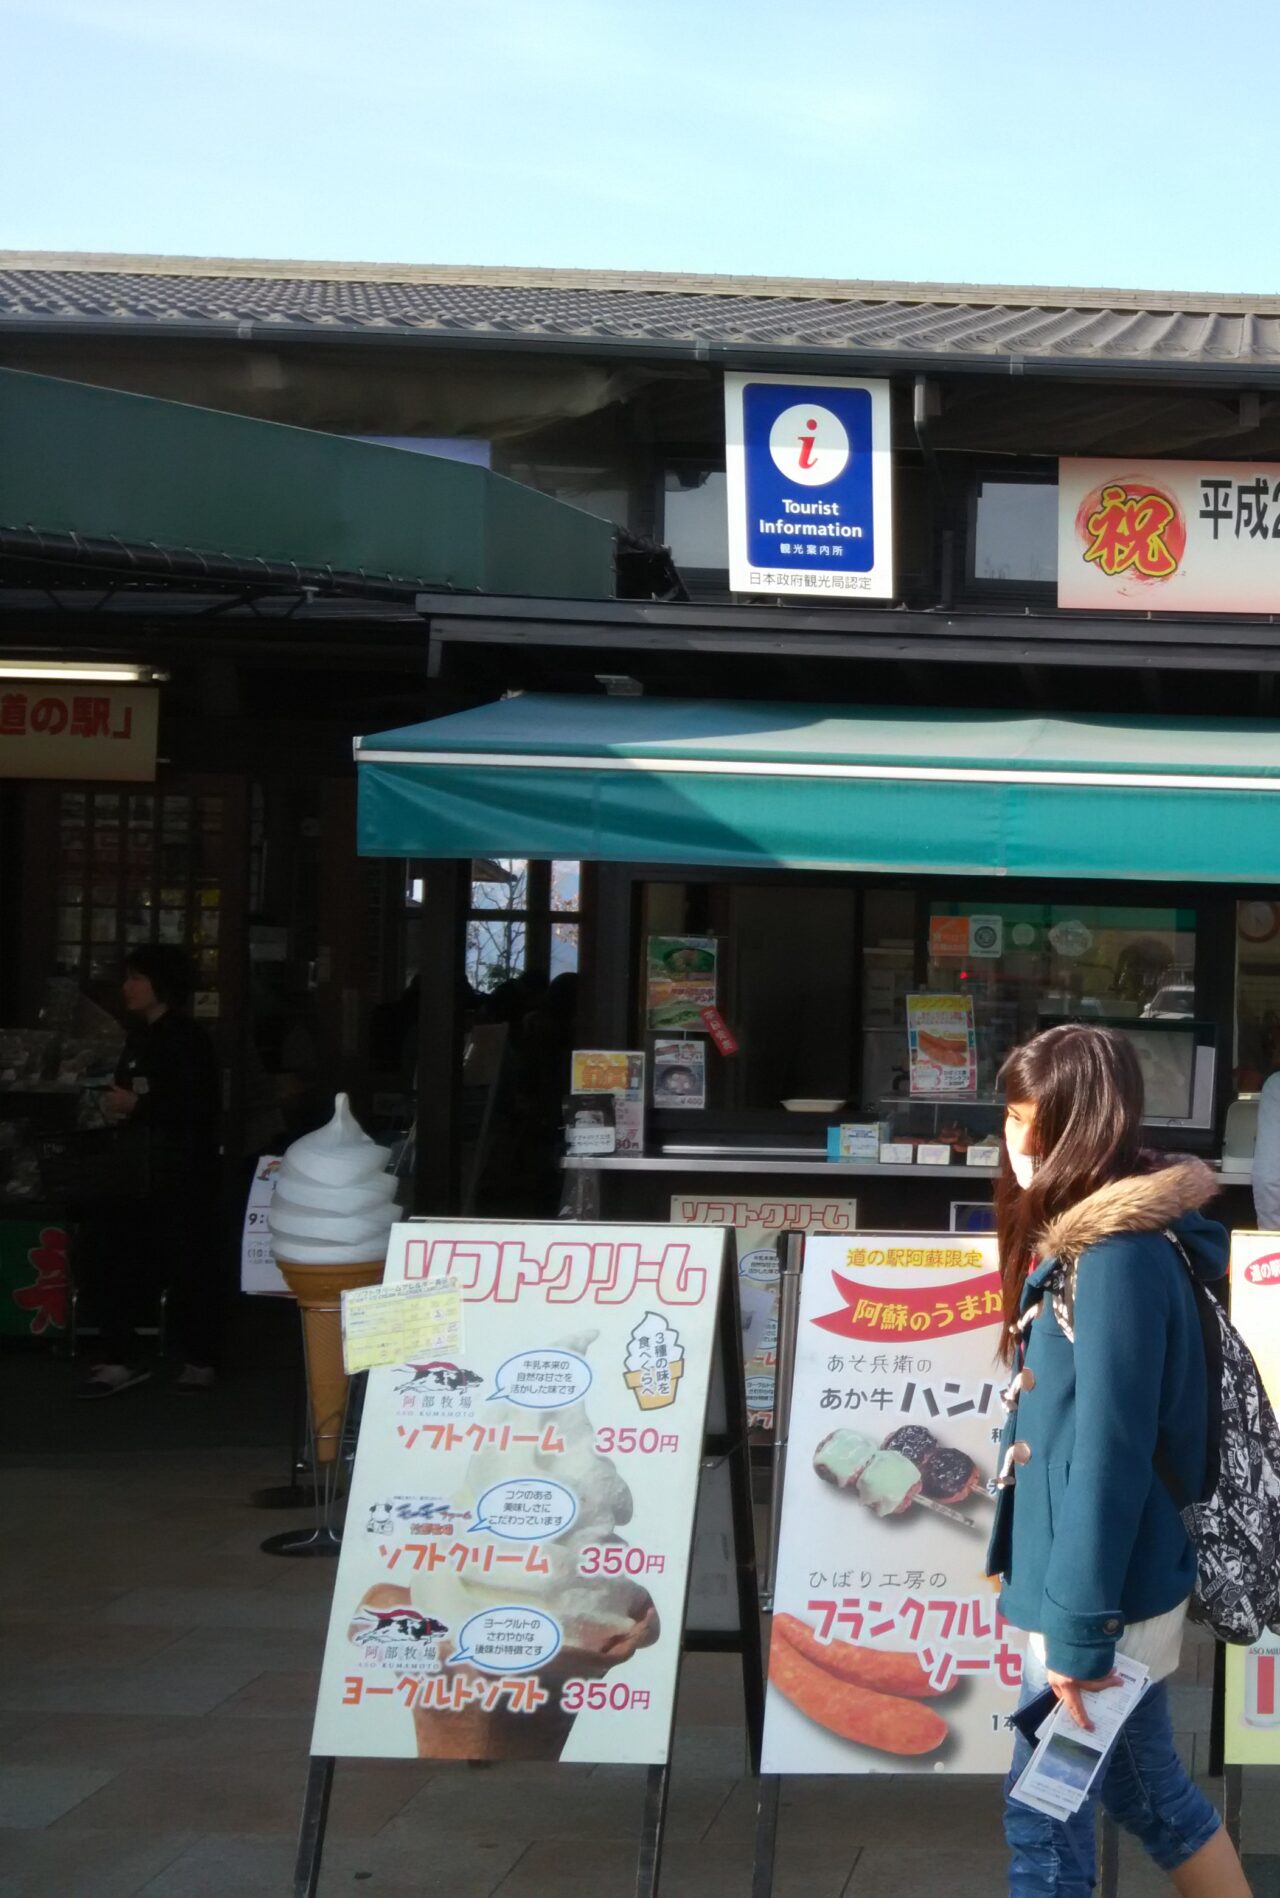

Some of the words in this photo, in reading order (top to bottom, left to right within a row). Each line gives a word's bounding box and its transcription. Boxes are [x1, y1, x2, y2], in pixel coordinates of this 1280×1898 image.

[782, 499, 839, 516] Tourist
[759, 519, 862, 538] Information
[1087, 485, 1177, 577] 祝
[780, 542, 843, 557] 観光案内所
[749, 572, 872, 591] 日本政府観光局認定
[847, 1249, 983, 1268] 道の駅阿蘇限定
[404, 1240, 708, 1306] ソフトクリーム
[851, 1289, 1003, 1332] 阿蘇のうまか
[522, 1360, 570, 1370] 牛乳本来の
[826, 1354, 932, 1374] あそ兵衛の
[516, 1372, 573, 1383] 自然な甘さを
[510, 1384, 577, 1395] 活かした味です
[402, 1395, 473, 1409] 阿部牧場
[397, 1423, 565, 1453] ソフトクリーム
[594, 1427, 680, 1453] 350円
[505, 1490, 553, 1501] コクのある
[503, 1503, 551, 1513] 美味しさに
[488, 1515, 564, 1526] こだわっています
[379, 1542, 549, 1574] ソフトクリーム
[580, 1546, 666, 1575] 350円
[808, 1570, 948, 1589] ひばり工房の
[483, 1618, 542, 1630] ヨーグルトの
[486, 1632, 535, 1643] さわやかな
[363, 1646, 438, 1660] 阿部牧場
[922, 1646, 1022, 1686] ソーセ
[341, 1676, 547, 1712] ヨーグルトソフト
[562, 1682, 652, 1711] 350円
